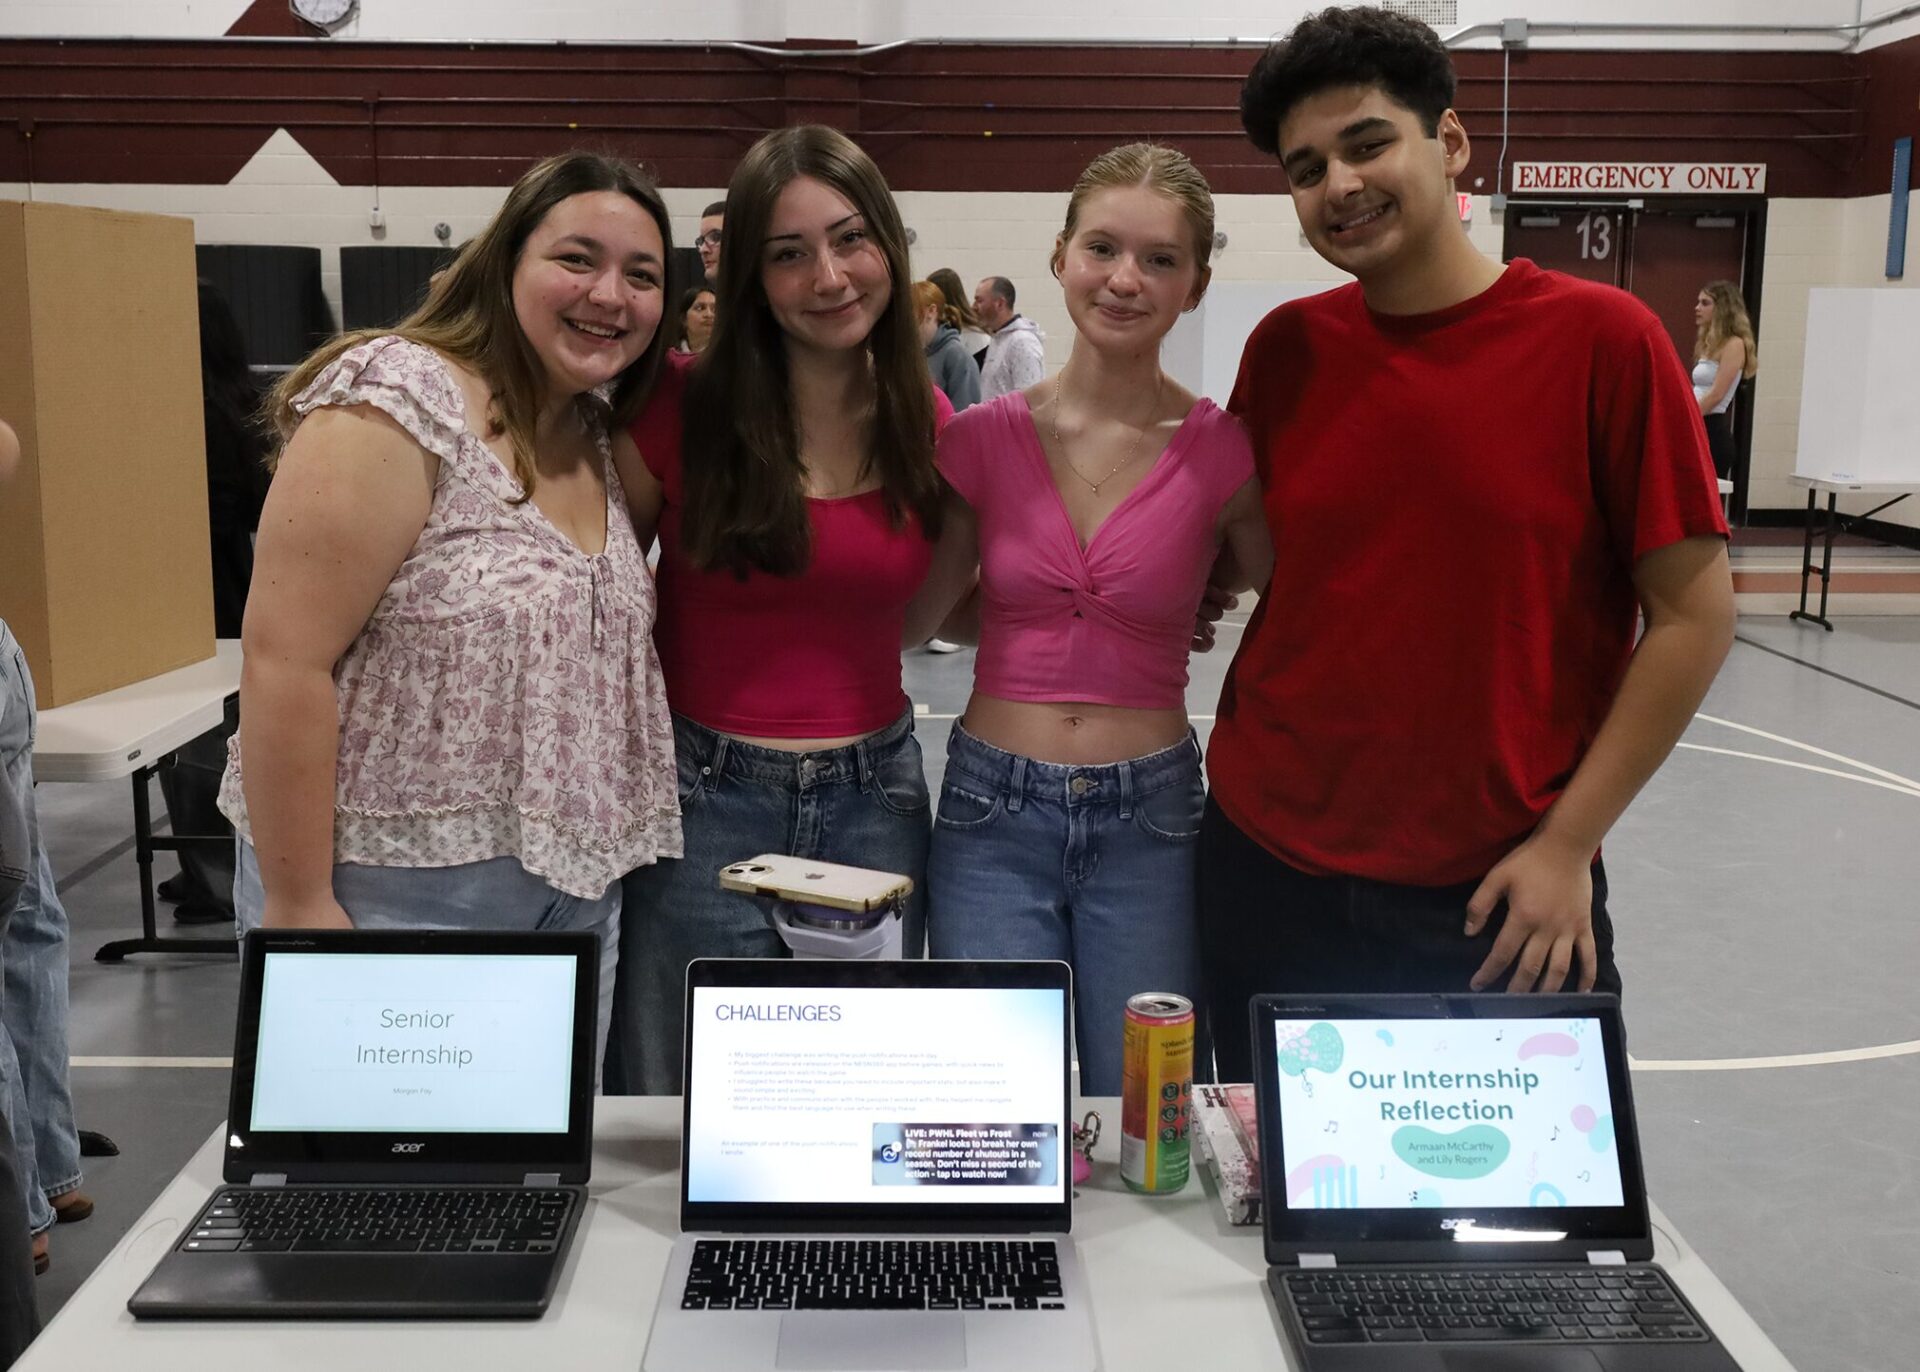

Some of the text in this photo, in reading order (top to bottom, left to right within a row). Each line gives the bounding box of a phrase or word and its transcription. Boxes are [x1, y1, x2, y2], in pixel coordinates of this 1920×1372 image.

[1518, 164, 1761, 191] EMERGENCY ONLY
[1576, 215, 1611, 260] 13
[380, 1008, 455, 1029] Senior
[715, 1004, 842, 1022] CHALLENGES
[356, 1043, 473, 1069] Internship
[1348, 1067, 1540, 1095] Our Internship
[1380, 1100, 1514, 1121] Reflection
[905, 1129, 928, 1138] LIVE:
[929, 1129, 954, 1138] PWHL
[956, 1129, 977, 1138] Fleet
[991, 1129, 1012, 1138] Frost
[391, 1142, 425, 1154] acer
[918, 1139, 947, 1148] Frankel
[949, 1139, 970, 1148] looks
[972, 1139, 981, 1148] to
[982, 1139, 1004, 1148] break
[1006, 1139, 1019, 1148] her
[1408, 1141, 1494, 1154] Armaan McCarthy
[932, 1149, 962, 1158] number
[964, 1149, 974, 1158] of
[1417, 1154, 1488, 1166] and Lily Rogers
[1028, 1159, 1042, 1168] the
[961, 1169, 986, 1178] watch
